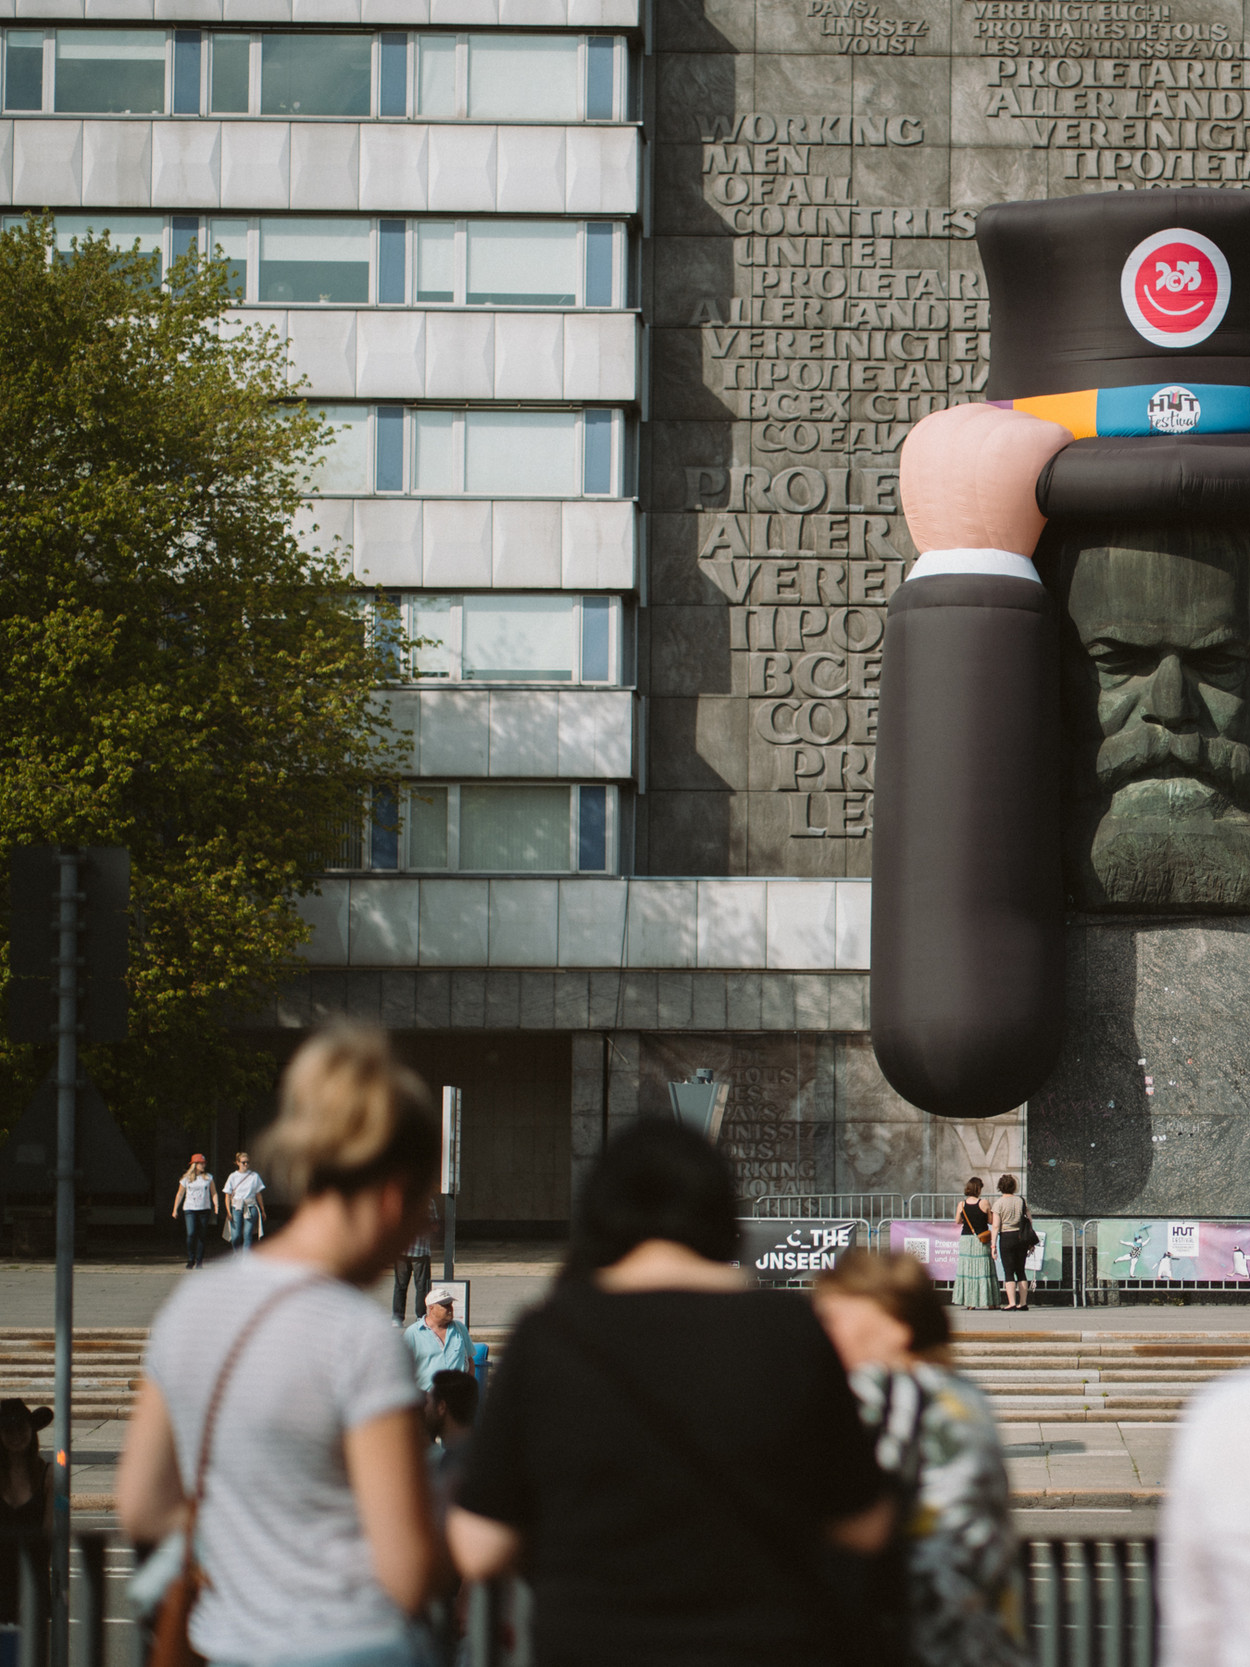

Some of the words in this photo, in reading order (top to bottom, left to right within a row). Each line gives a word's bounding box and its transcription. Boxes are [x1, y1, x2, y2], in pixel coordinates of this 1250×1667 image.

[986, 88, 1116, 119] ALLER
[699, 112, 925, 146] WORKING
[702, 145, 811, 174] MEN
[711, 176, 776, 205] OF
[777, 176, 859, 206] ALL
[731, 207, 978, 239] COUNTRIES
[735, 236, 893, 268] UNITE!
[689, 298, 825, 329] ALLER
[703, 329, 950, 361] VEREINIGT
[722, 361, 990, 393] ПРОЛЕТАРИ
[738, 392, 851, 422] ВСЕХ
[700, 513, 904, 560] ALLER
[789, 792, 874, 838] LE
[1172, 1226, 1195, 1236] HUT
